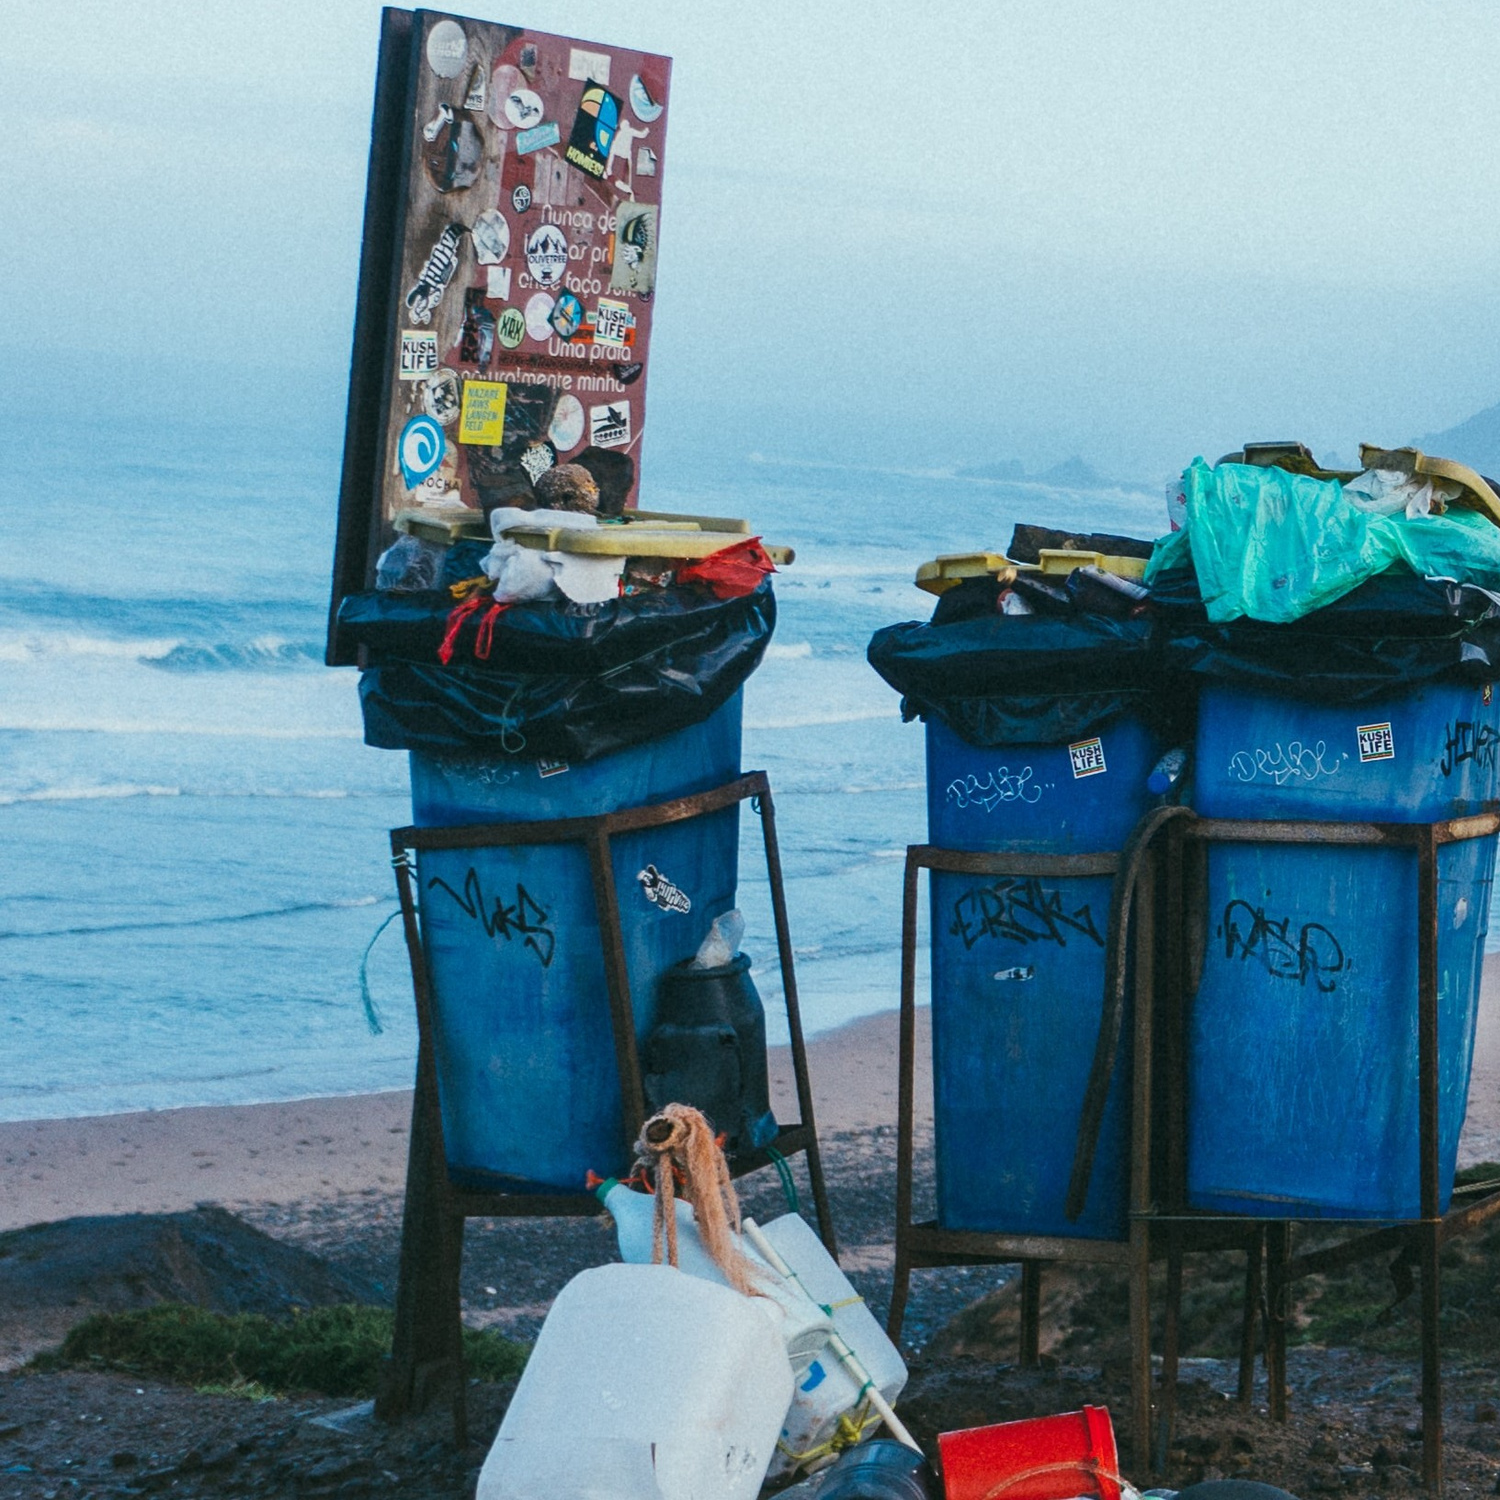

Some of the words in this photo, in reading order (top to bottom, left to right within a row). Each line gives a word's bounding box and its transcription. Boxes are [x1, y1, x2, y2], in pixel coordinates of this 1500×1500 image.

[541, 204, 593, 227] Nunca
[598, 211, 617, 233] de
[528, 255, 567, 264] OLIVETREE
[568, 245, 588, 260] as
[565, 271, 601, 298] faço
[599, 308, 627, 324] KUSH
[596, 320, 625, 338] LIFE
[402, 341, 437, 354] KUSH
[549, 337, 586, 360] Uma
[401, 354, 438, 369] LIFE
[420, 477, 460, 491] OCHA
[1360, 730, 1391, 743] KUSH
[1071, 744, 1102, 759] KUSH
[1361, 740, 1392, 754] LIFE
[1073, 754, 1104, 770] LIFE
